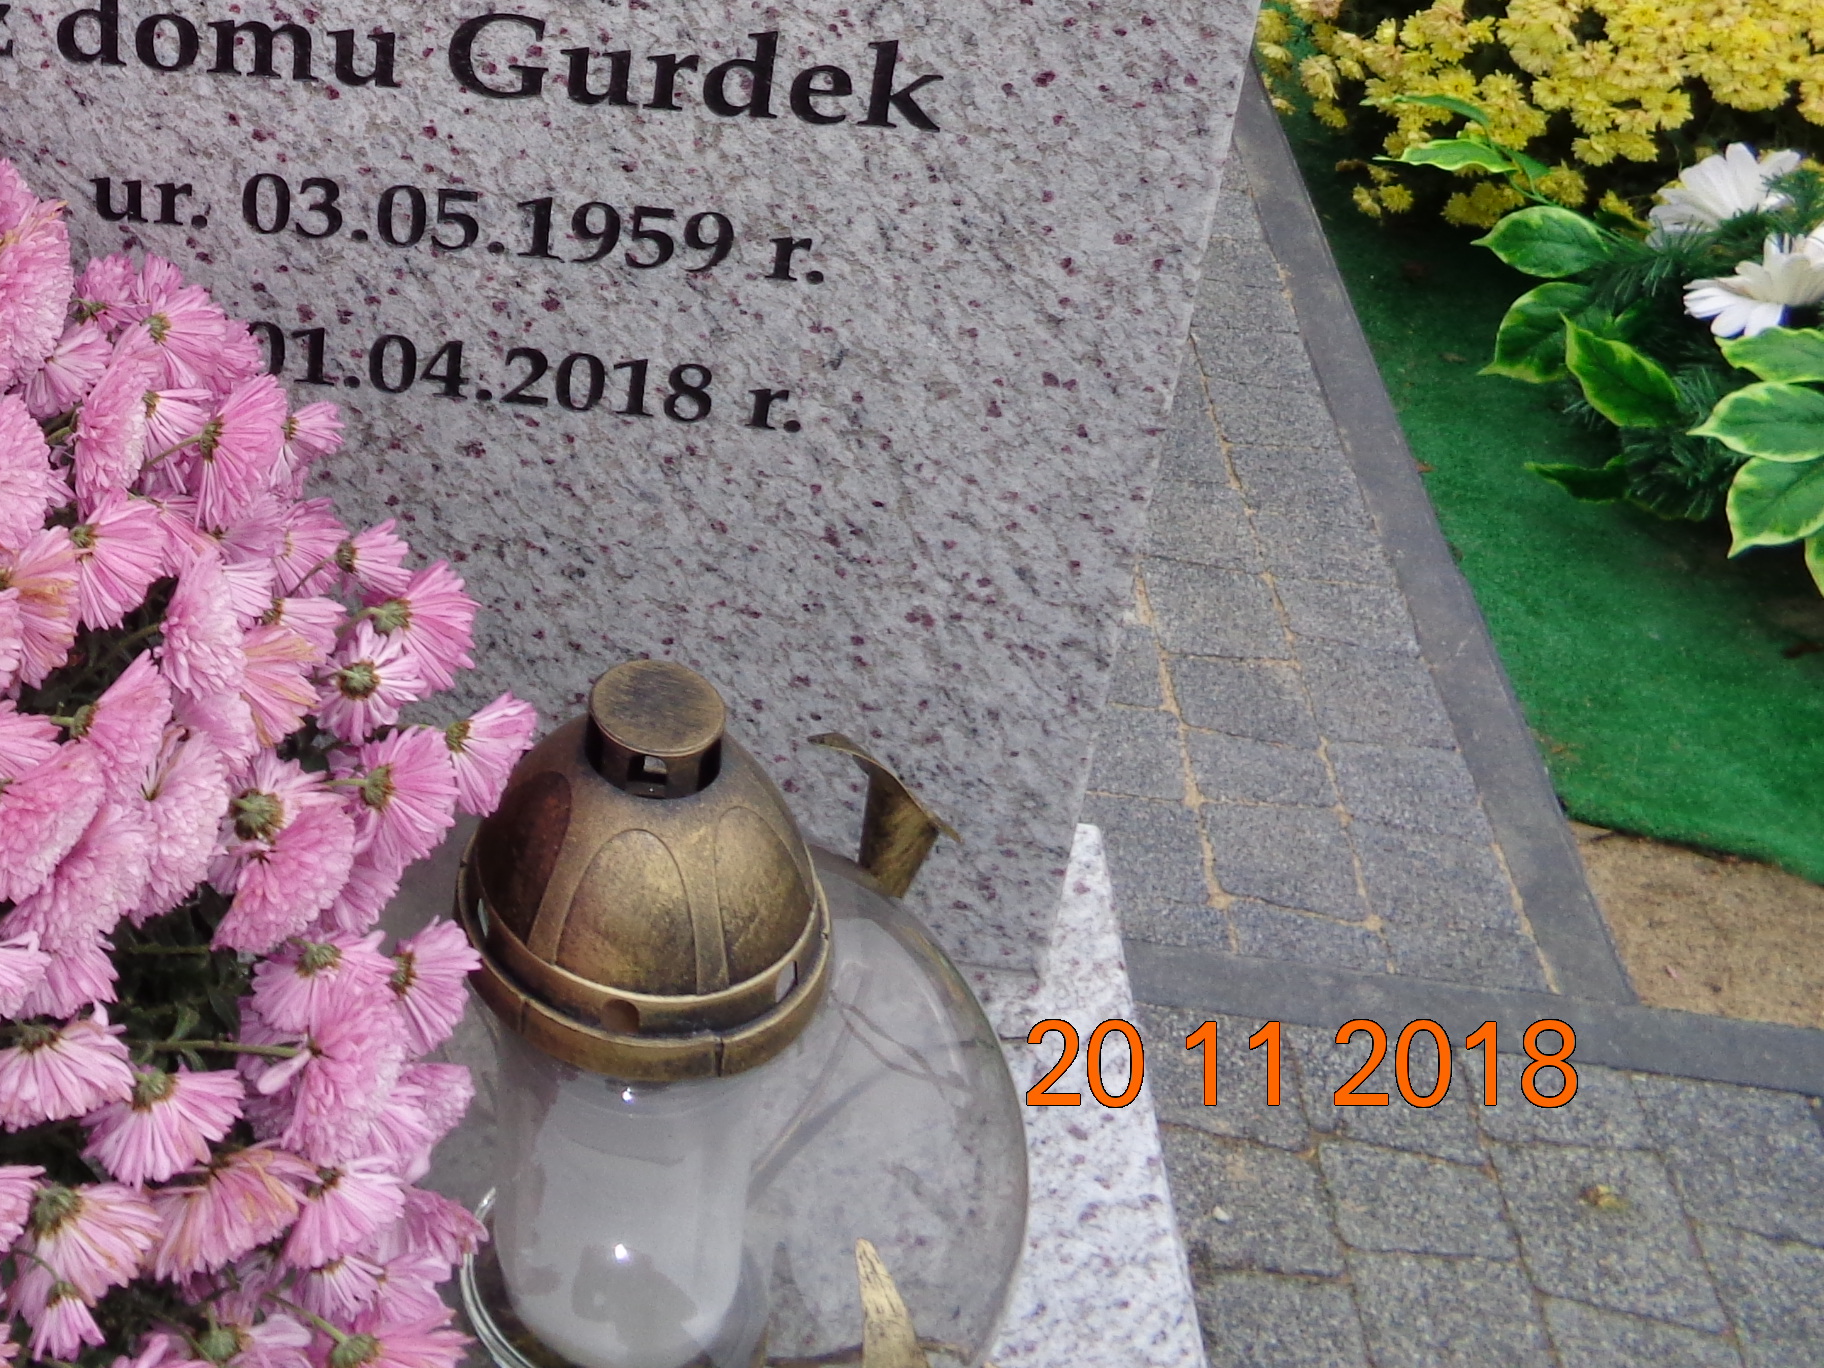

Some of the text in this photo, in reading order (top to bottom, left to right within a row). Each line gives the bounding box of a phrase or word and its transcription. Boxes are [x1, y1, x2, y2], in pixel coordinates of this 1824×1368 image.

[448, 13, 943, 131] Gurdek
[91, 172, 826, 285] ur. 03.05.1959 r.
[747, 389, 804, 434] r.
